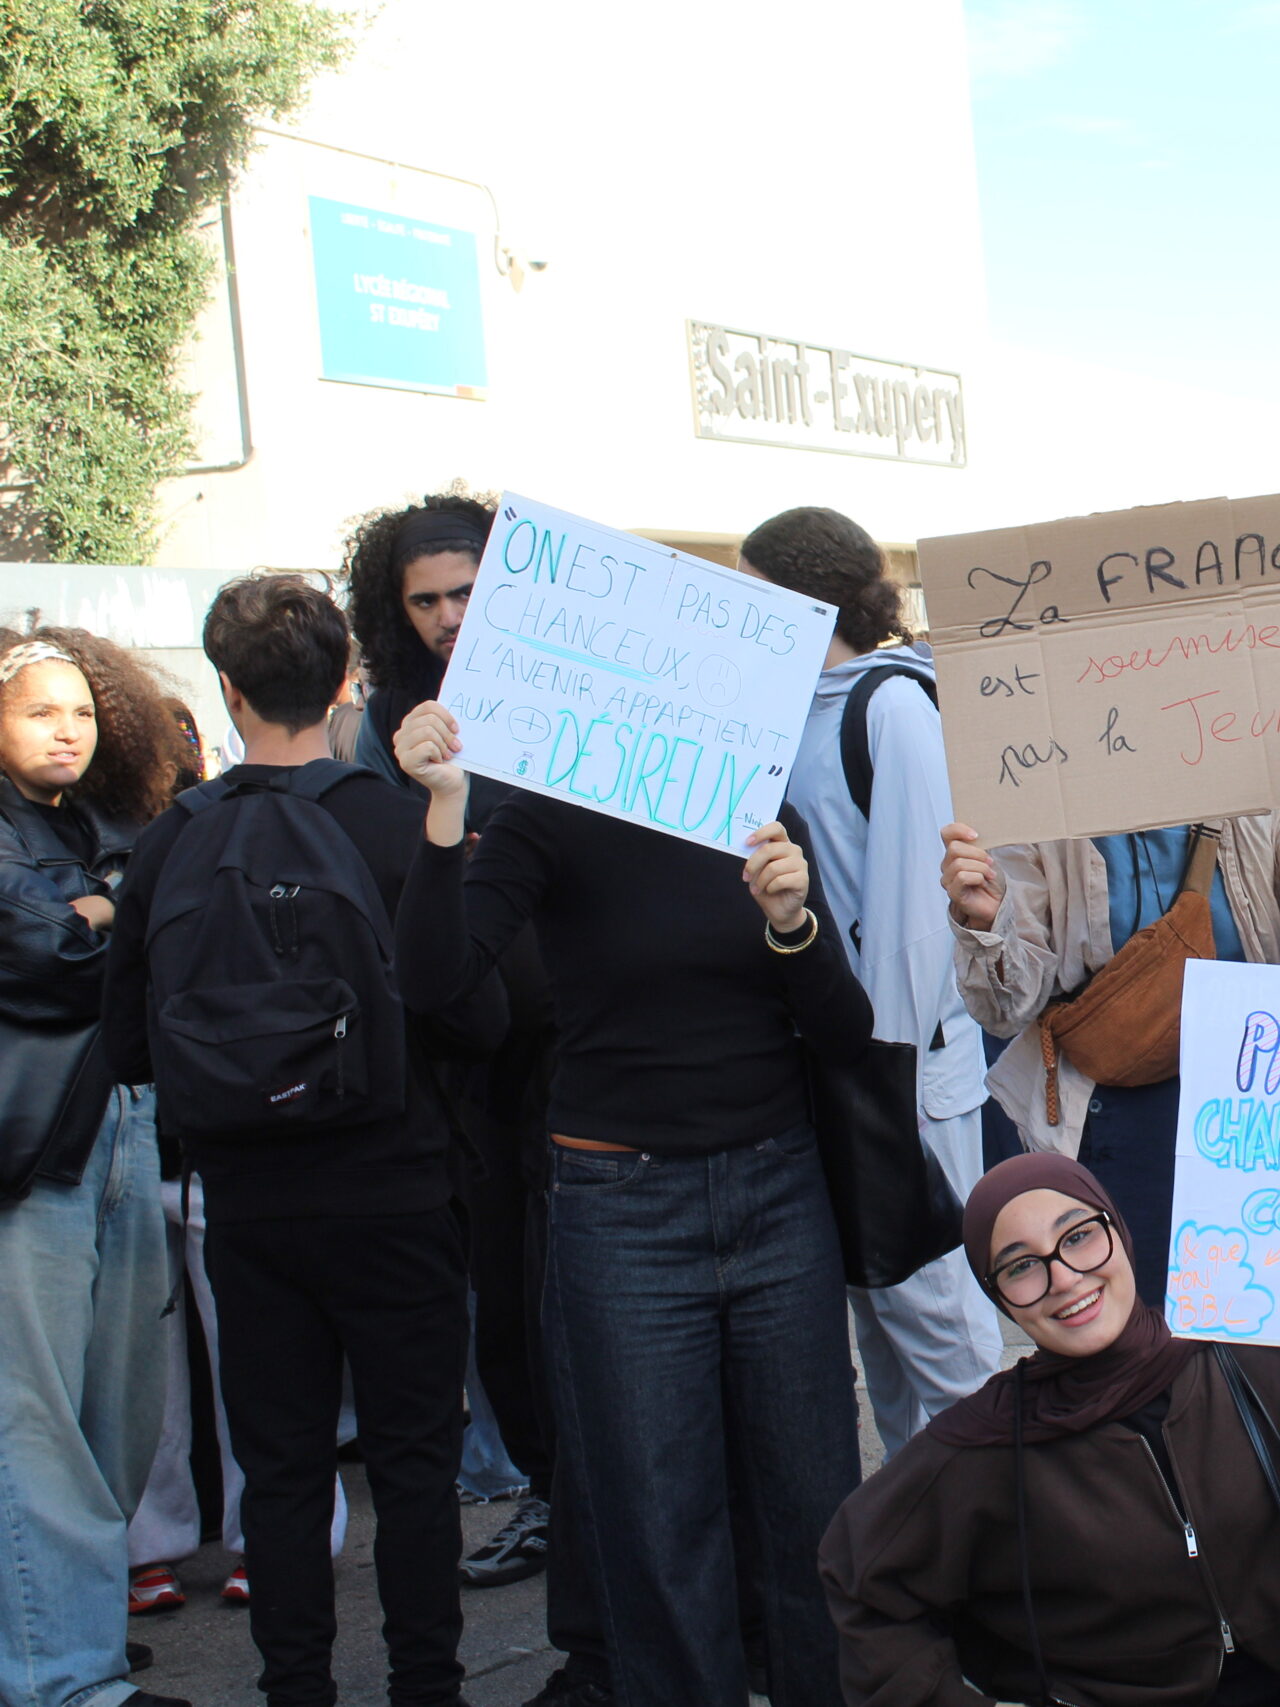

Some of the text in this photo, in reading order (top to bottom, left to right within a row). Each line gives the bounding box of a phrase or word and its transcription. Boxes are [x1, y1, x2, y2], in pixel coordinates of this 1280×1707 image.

[566, 544, 648, 605] EST
[677, 583, 731, 629] PAS
[740, 603, 799, 656] DES
[967, 559, 1069, 638] La
[484, 584, 691, 690] CHANCEUX,
[980, 663, 1040, 697] est
[448, 693, 505, 723] AUX
[999, 736, 1069, 788] pas
[1099, 707, 1136, 755] la
[270, 1082, 307, 1103] EASTPAK
[1207, 1244, 1241, 1275] que
[1169, 1268, 1211, 1293] MON
[1176, 1294, 1249, 1327] BBL
